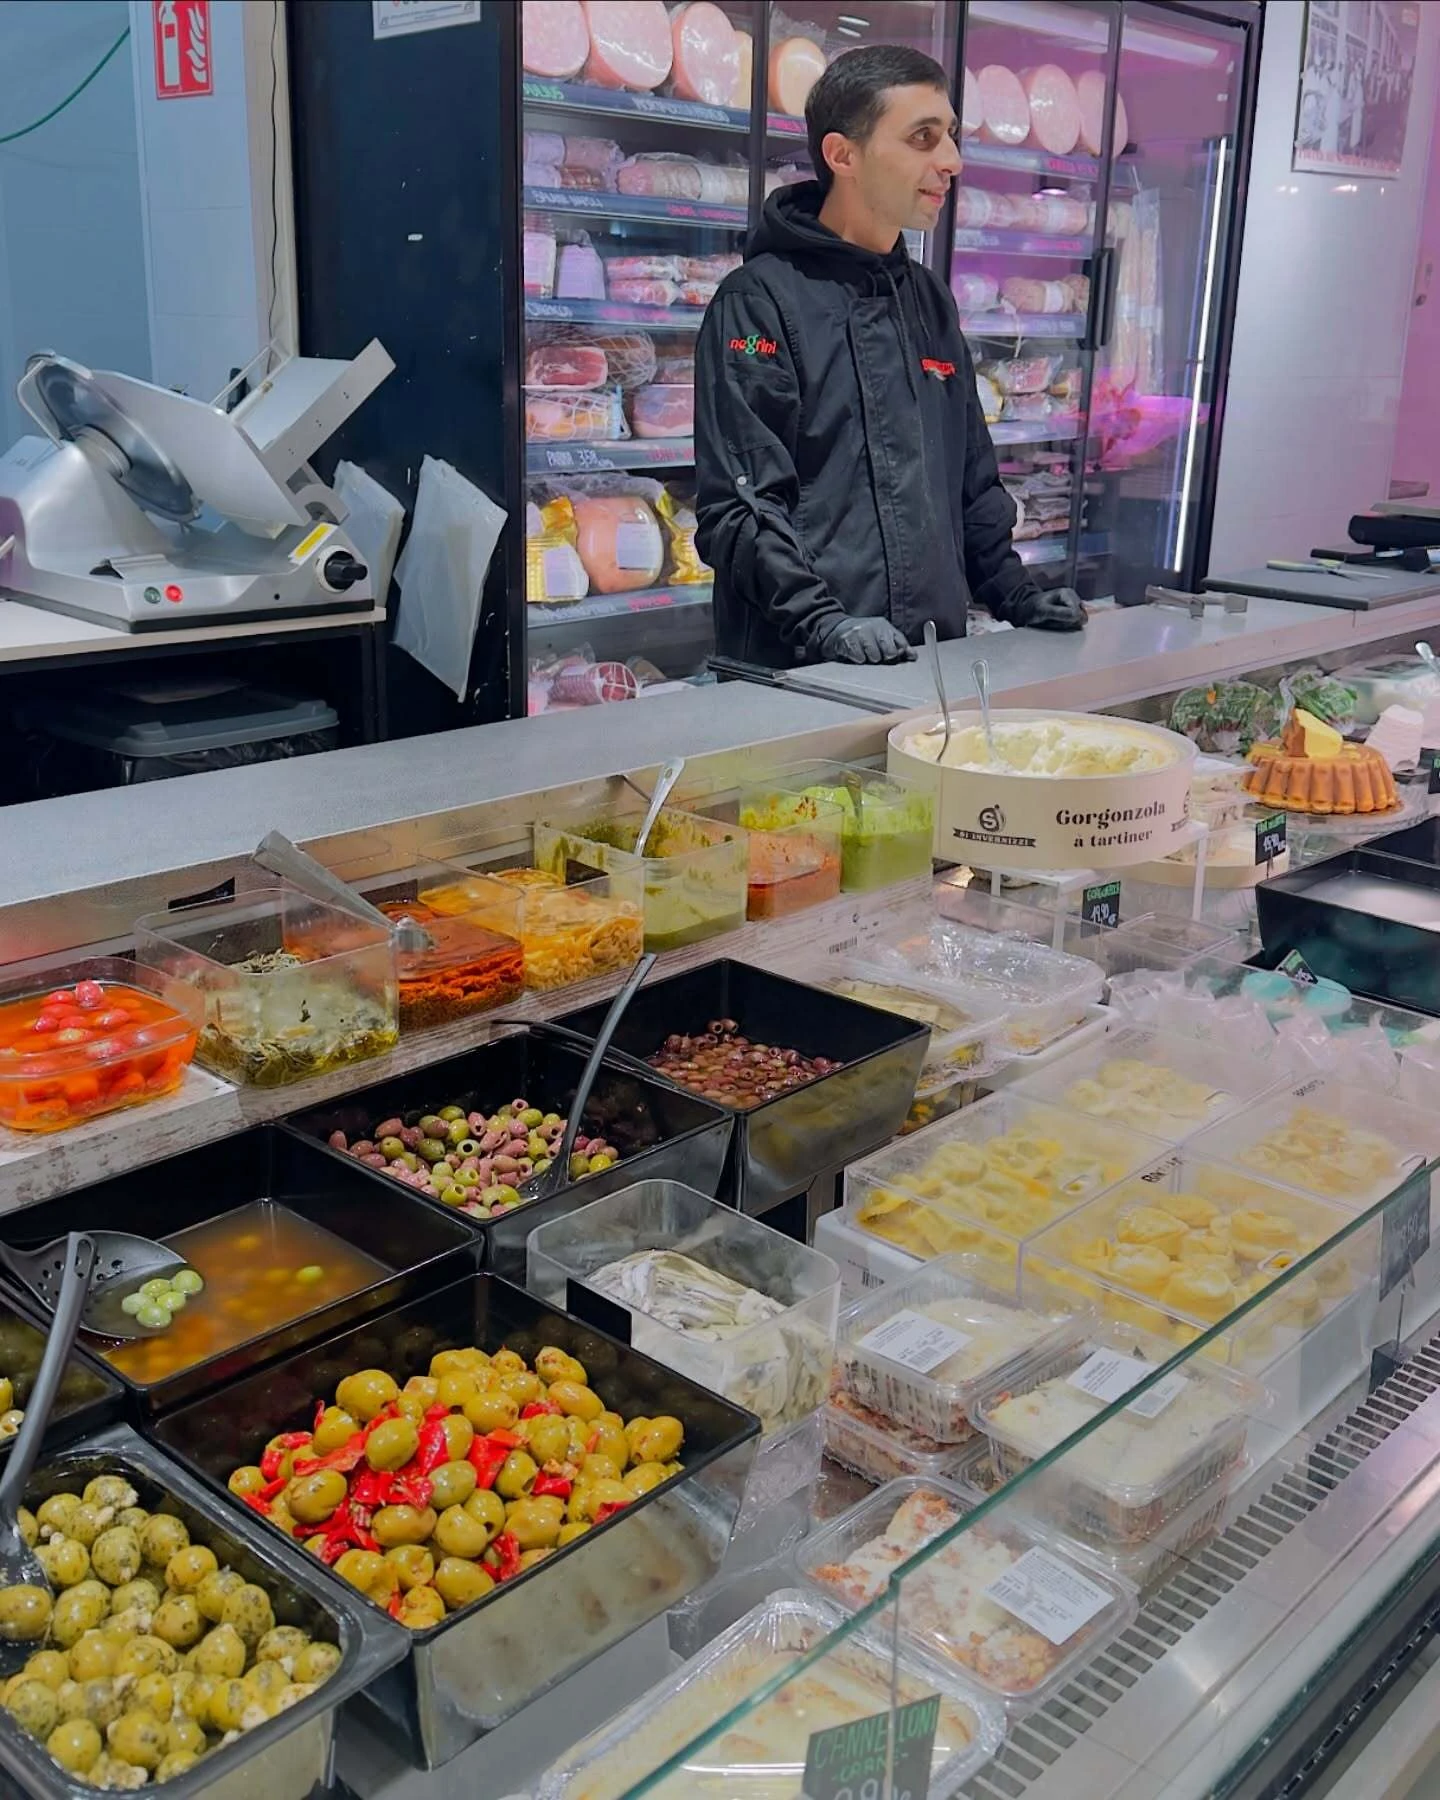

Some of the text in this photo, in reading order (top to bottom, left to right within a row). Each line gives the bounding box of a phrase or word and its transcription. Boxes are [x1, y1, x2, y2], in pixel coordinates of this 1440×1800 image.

[730, 334, 777, 355] negrini
[1056, 801, 1165, 830] Gorgonzola
[1074, 830, 1153, 848] à tartiner
